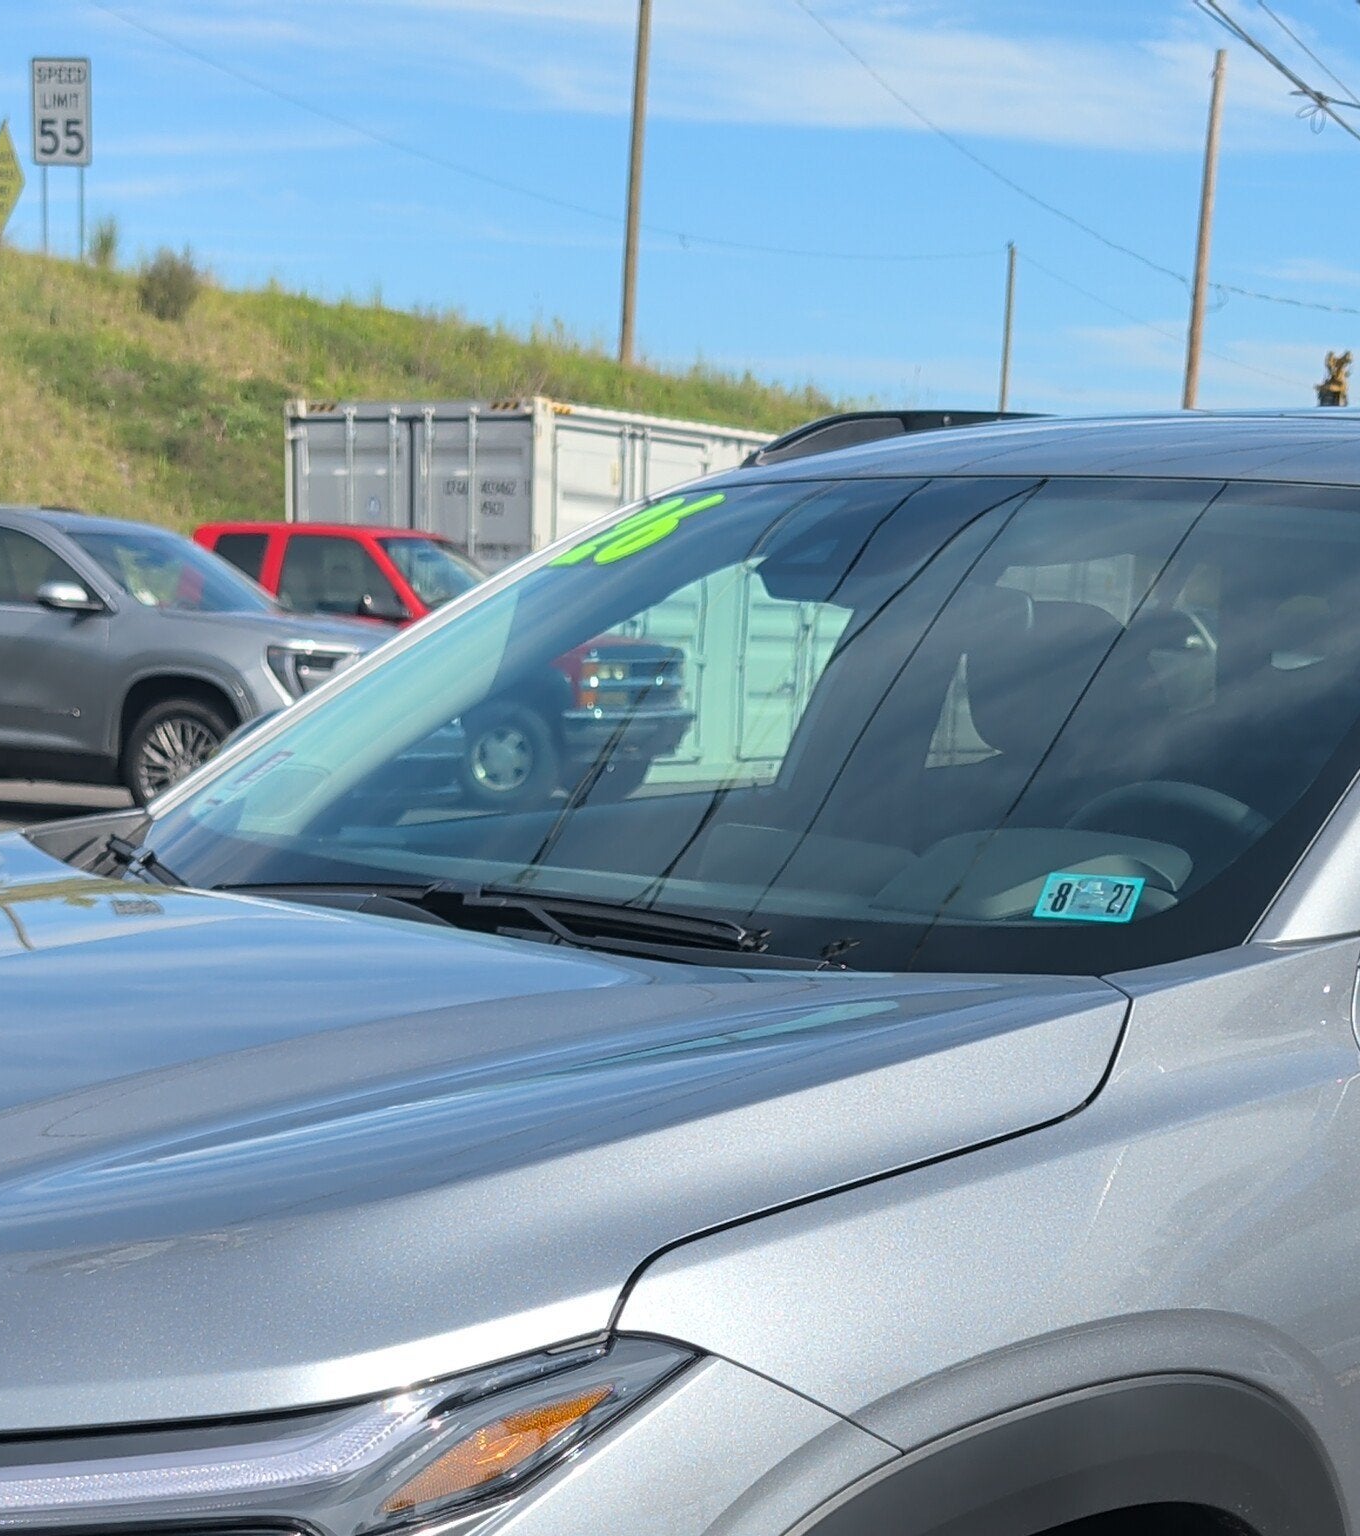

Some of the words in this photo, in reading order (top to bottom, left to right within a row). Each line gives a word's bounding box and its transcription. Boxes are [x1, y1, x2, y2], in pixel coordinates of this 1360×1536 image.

[36, 66, 87, 84] SPEED
[42, 93, 79, 109] LIMIT
[40, 118, 84, 155] 55
[1050, 882, 1072, 912] 8
[1105, 883, 1134, 914] 27
